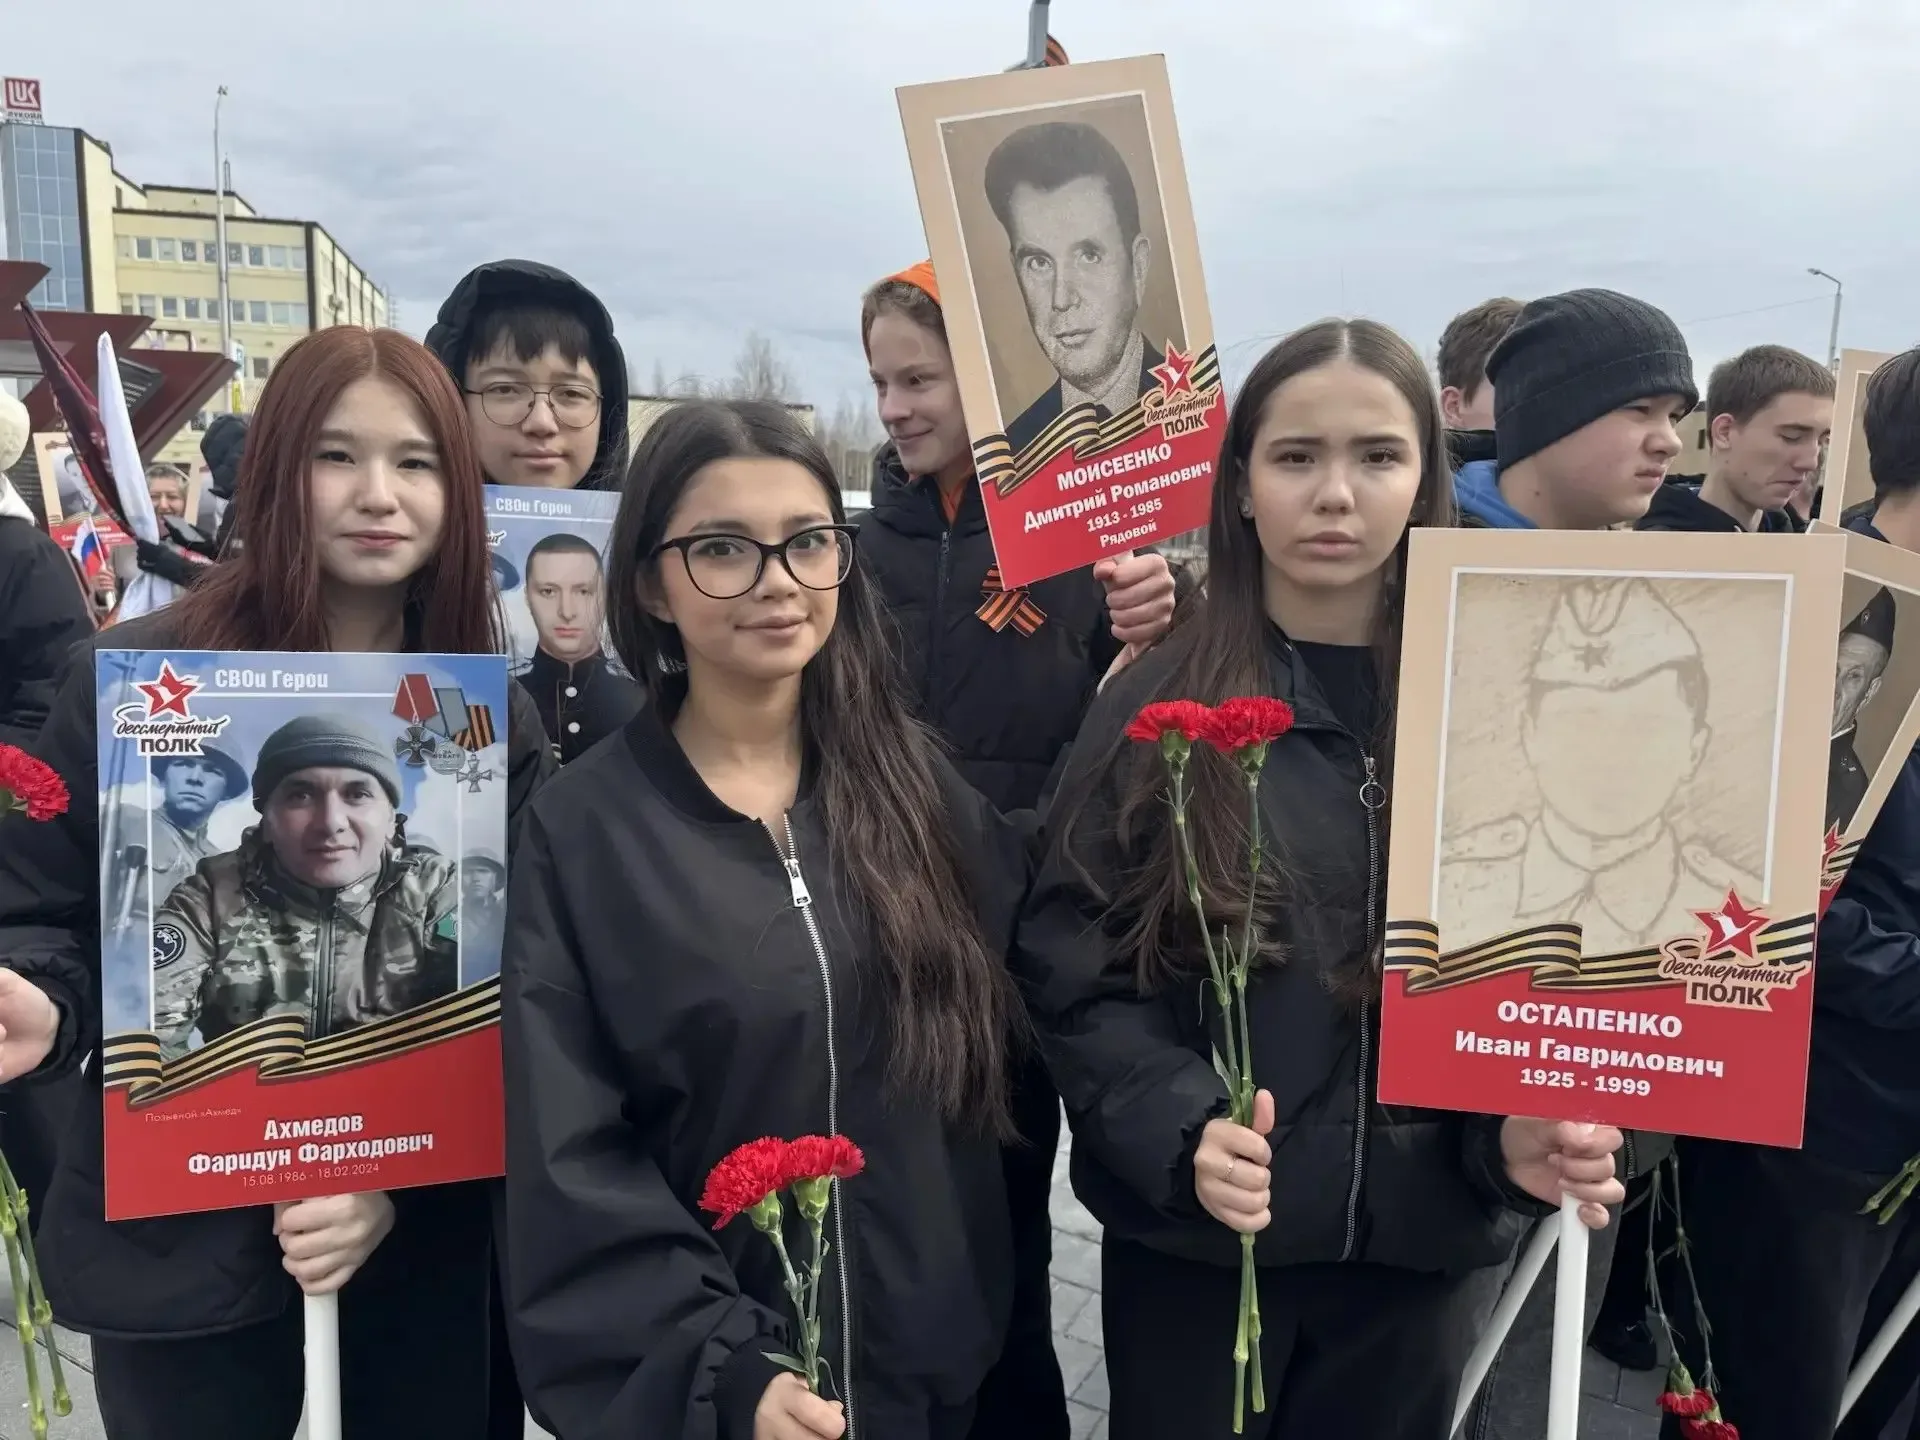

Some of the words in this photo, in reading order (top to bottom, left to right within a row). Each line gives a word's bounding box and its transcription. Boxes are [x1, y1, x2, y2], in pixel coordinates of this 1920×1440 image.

[1164, 412, 1205, 437] ПОЛК
[1057, 443, 1172, 491] МОИСЕЕНКО
[534, 500, 572, 516] Герои
[1023, 489, 1107, 533] Дмитрий
[1111, 460, 1211, 503] Романович
[1087, 511, 1121, 533] 1913
[1130, 498, 1163, 521] 1985
[1099, 519, 1157, 548] Рядовой
[271, 669, 329, 693] Герои
[140, 738, 199, 754] ПОЛК
[1690, 983, 1766, 1007] ПОЛК
[1497, 1000, 1683, 1038] ОСТАПЕНКО
[1455, 1030, 1530, 1058] Иван
[1539, 1039, 1725, 1077] Гаврилович
[1520, 1068, 1575, 1089] 1925
[1594, 1075, 1651, 1097] 1999
[264, 1113, 364, 1140] Ахмедов
[188, 1151, 292, 1175] Фаридун
[298, 1133, 434, 1164] Фарходович
[242, 1171, 307, 1187] 15.08.1986
[317, 1163, 380, 1179] 18.02.2024
